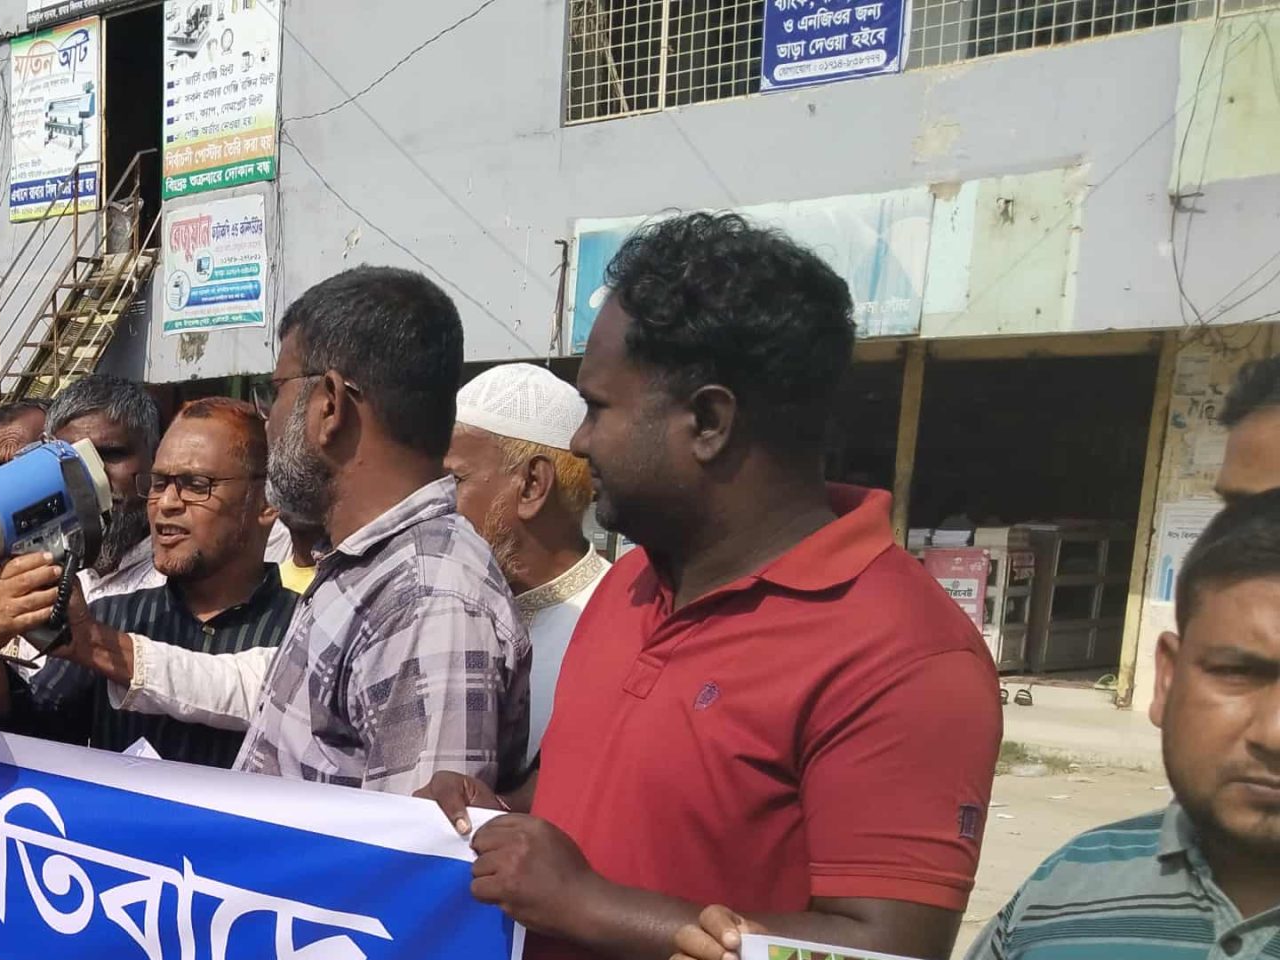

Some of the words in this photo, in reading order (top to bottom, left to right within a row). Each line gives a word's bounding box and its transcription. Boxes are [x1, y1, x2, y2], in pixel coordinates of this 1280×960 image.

[783, 19, 794, 33] ও
[797, 7, 852, 31] এনজিওর
[854, 2, 884, 22] জন্য
[776, 39, 806, 60] ভাড়া
[809, 33, 850, 55] দেওয়া
[850, 26, 889, 48] হইবে
